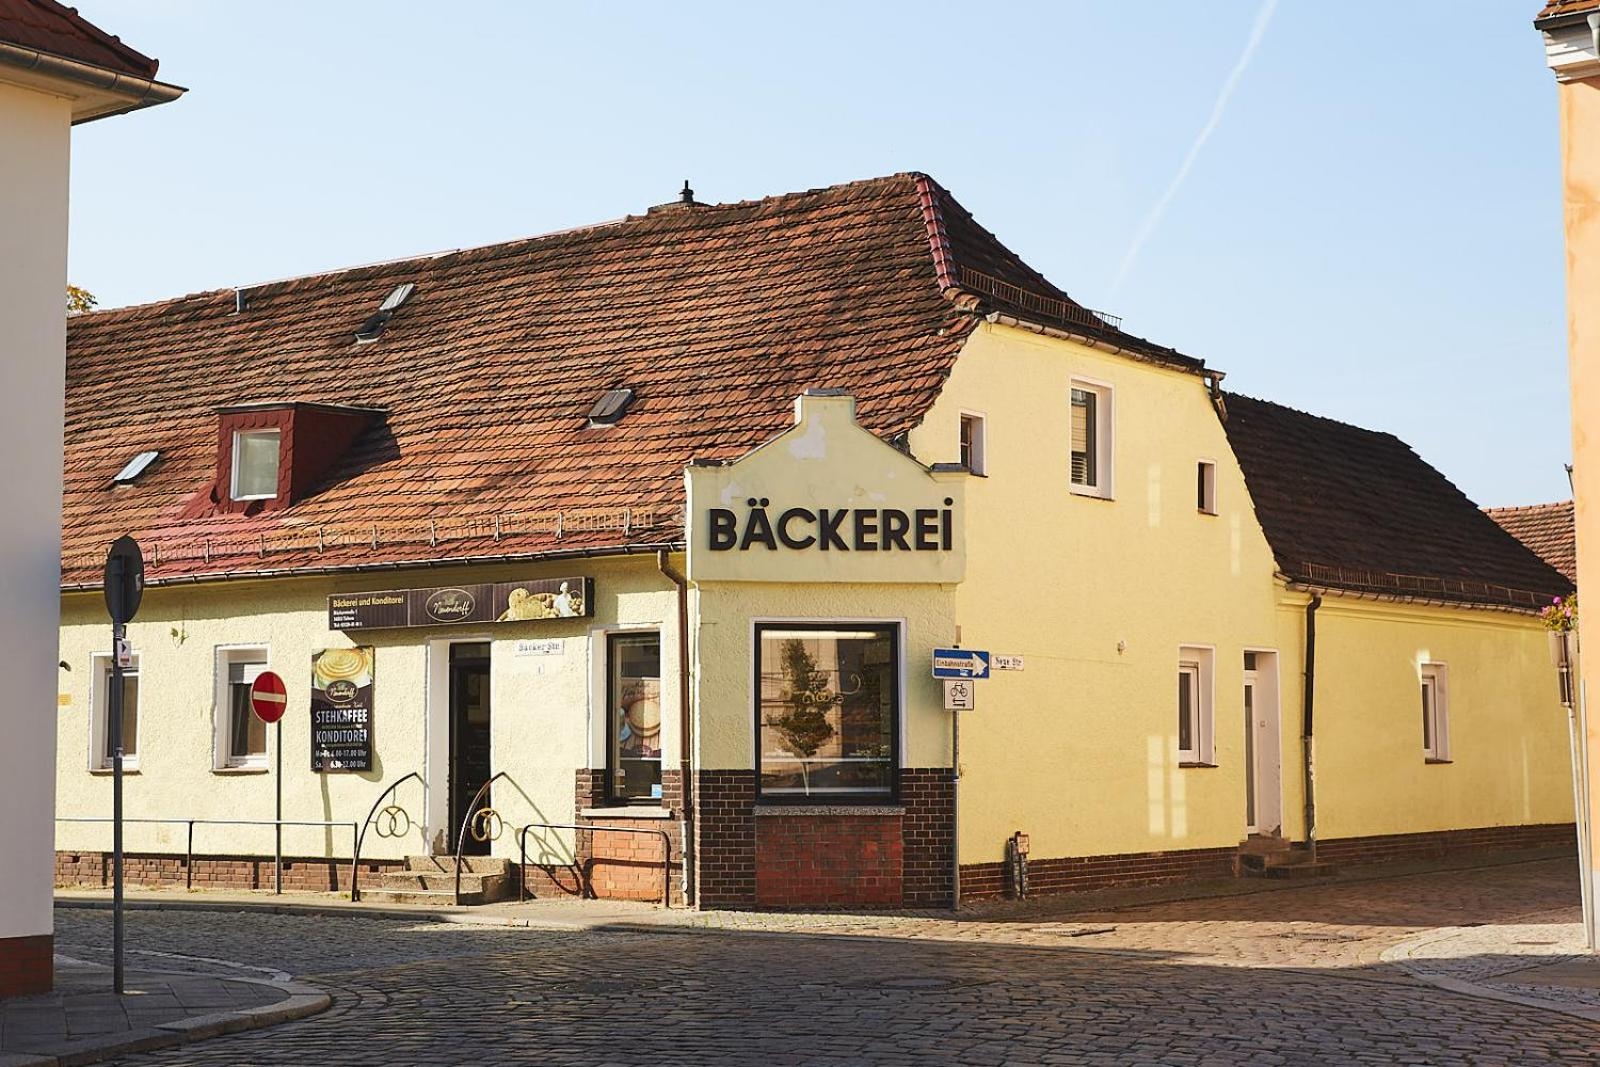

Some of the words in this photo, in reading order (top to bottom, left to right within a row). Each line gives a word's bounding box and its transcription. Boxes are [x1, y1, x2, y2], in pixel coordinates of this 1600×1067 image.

[333, 598, 358, 608] Bäckerei
[359, 597, 371, 606] und
[372, 594, 404, 605] Konditorei
[316, 709, 368, 723] STEHKAFFEE
[316, 729, 368, 743] KONDITOREI
